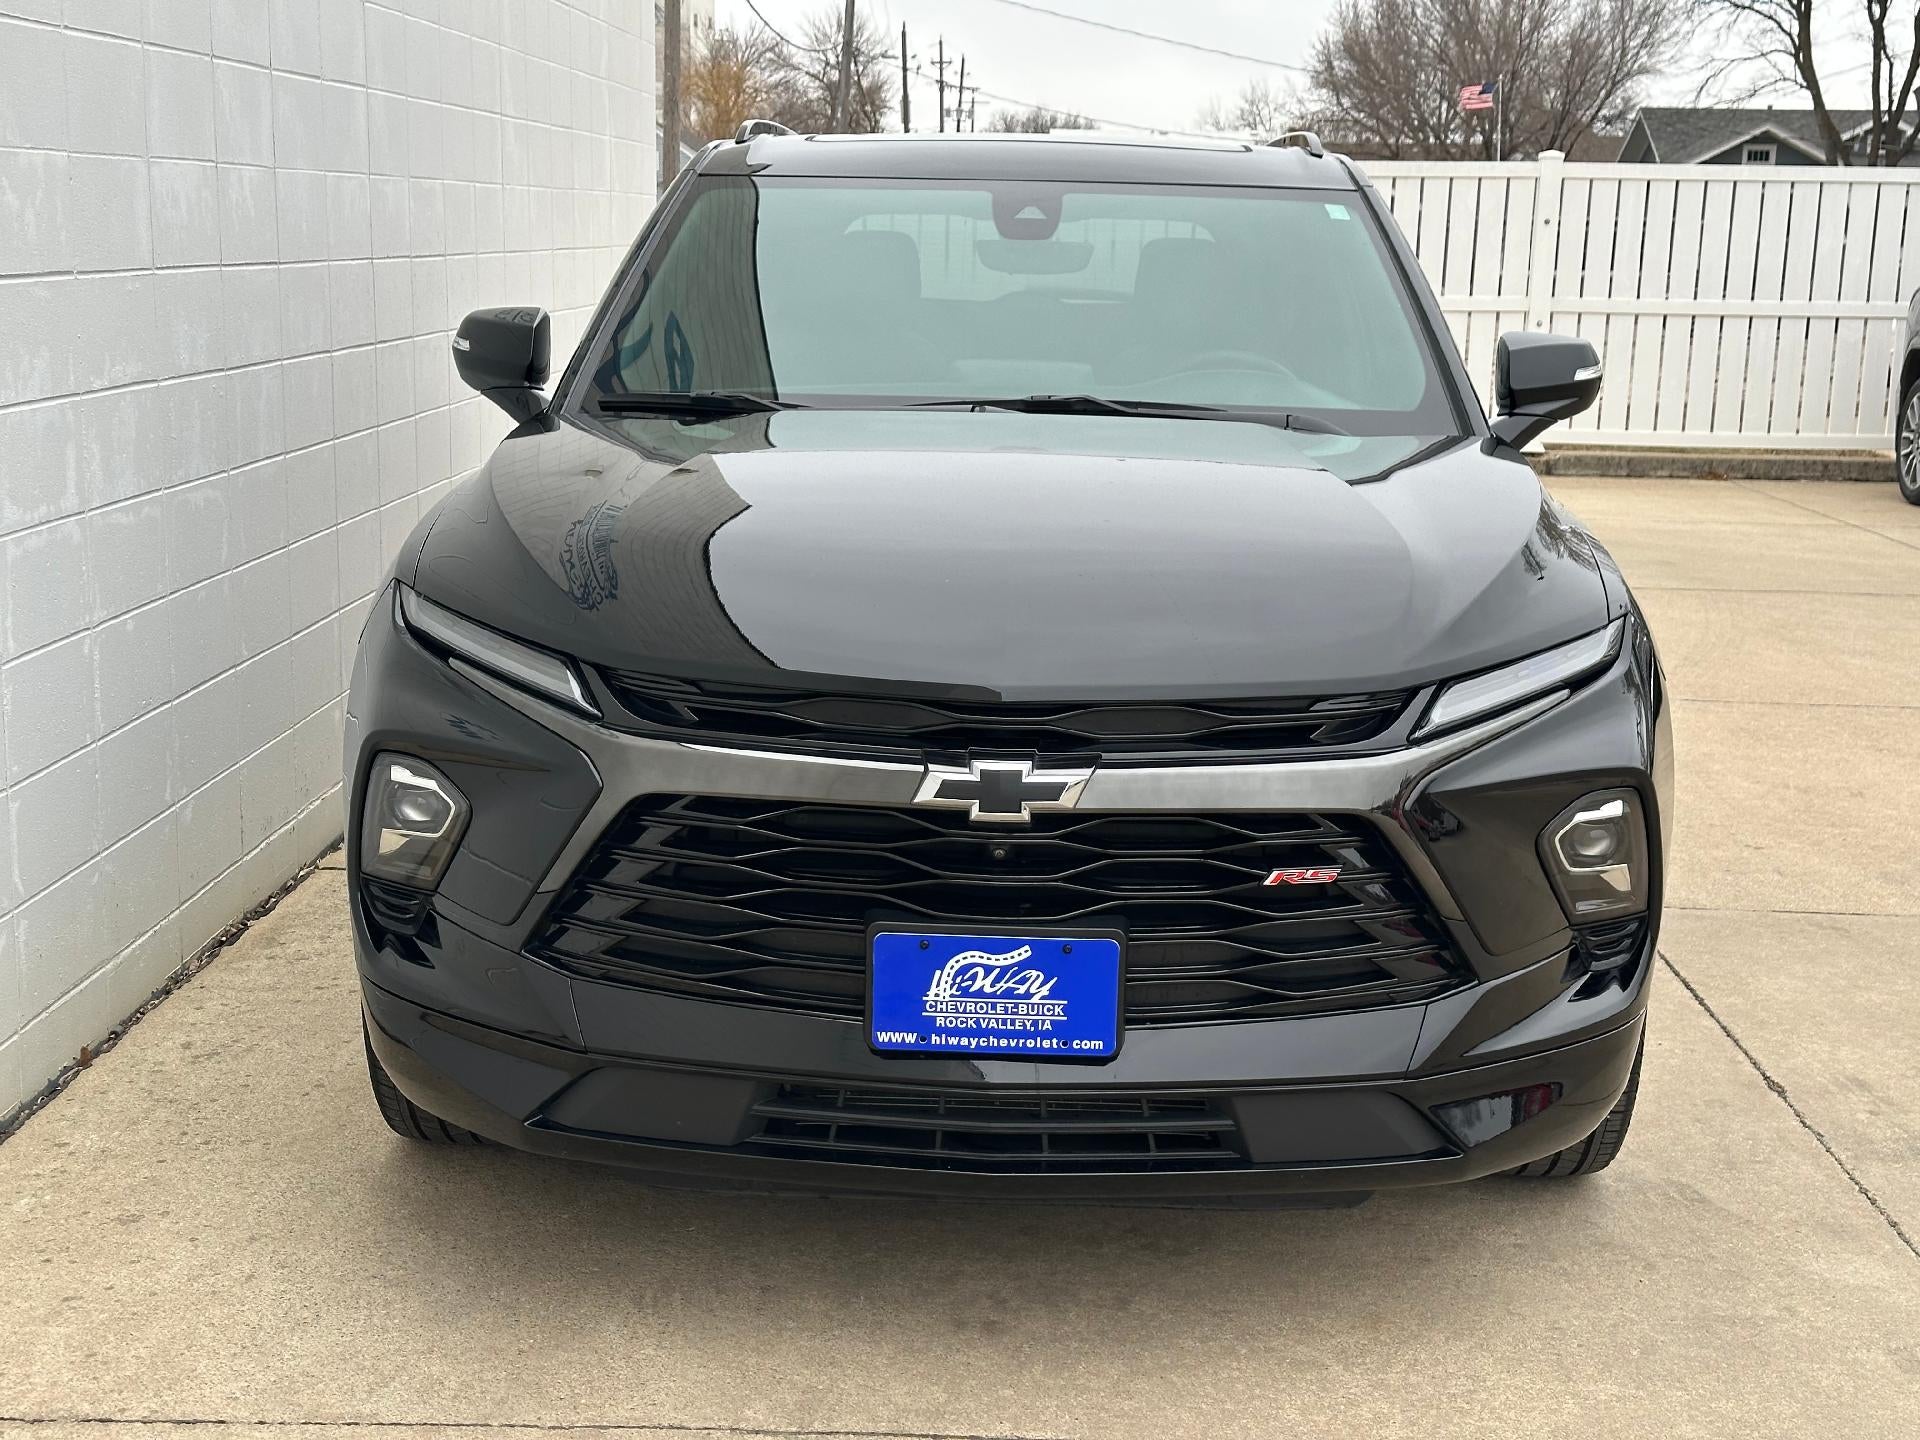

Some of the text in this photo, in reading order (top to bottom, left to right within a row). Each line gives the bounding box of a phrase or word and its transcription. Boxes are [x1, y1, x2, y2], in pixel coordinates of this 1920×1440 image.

[1263, 869, 1341, 886] RS
[925, 1001, 1065, 1016] CHEVROLET-BUICK
[936, 1017, 1053, 1032] ROCK VALLEY, IA
